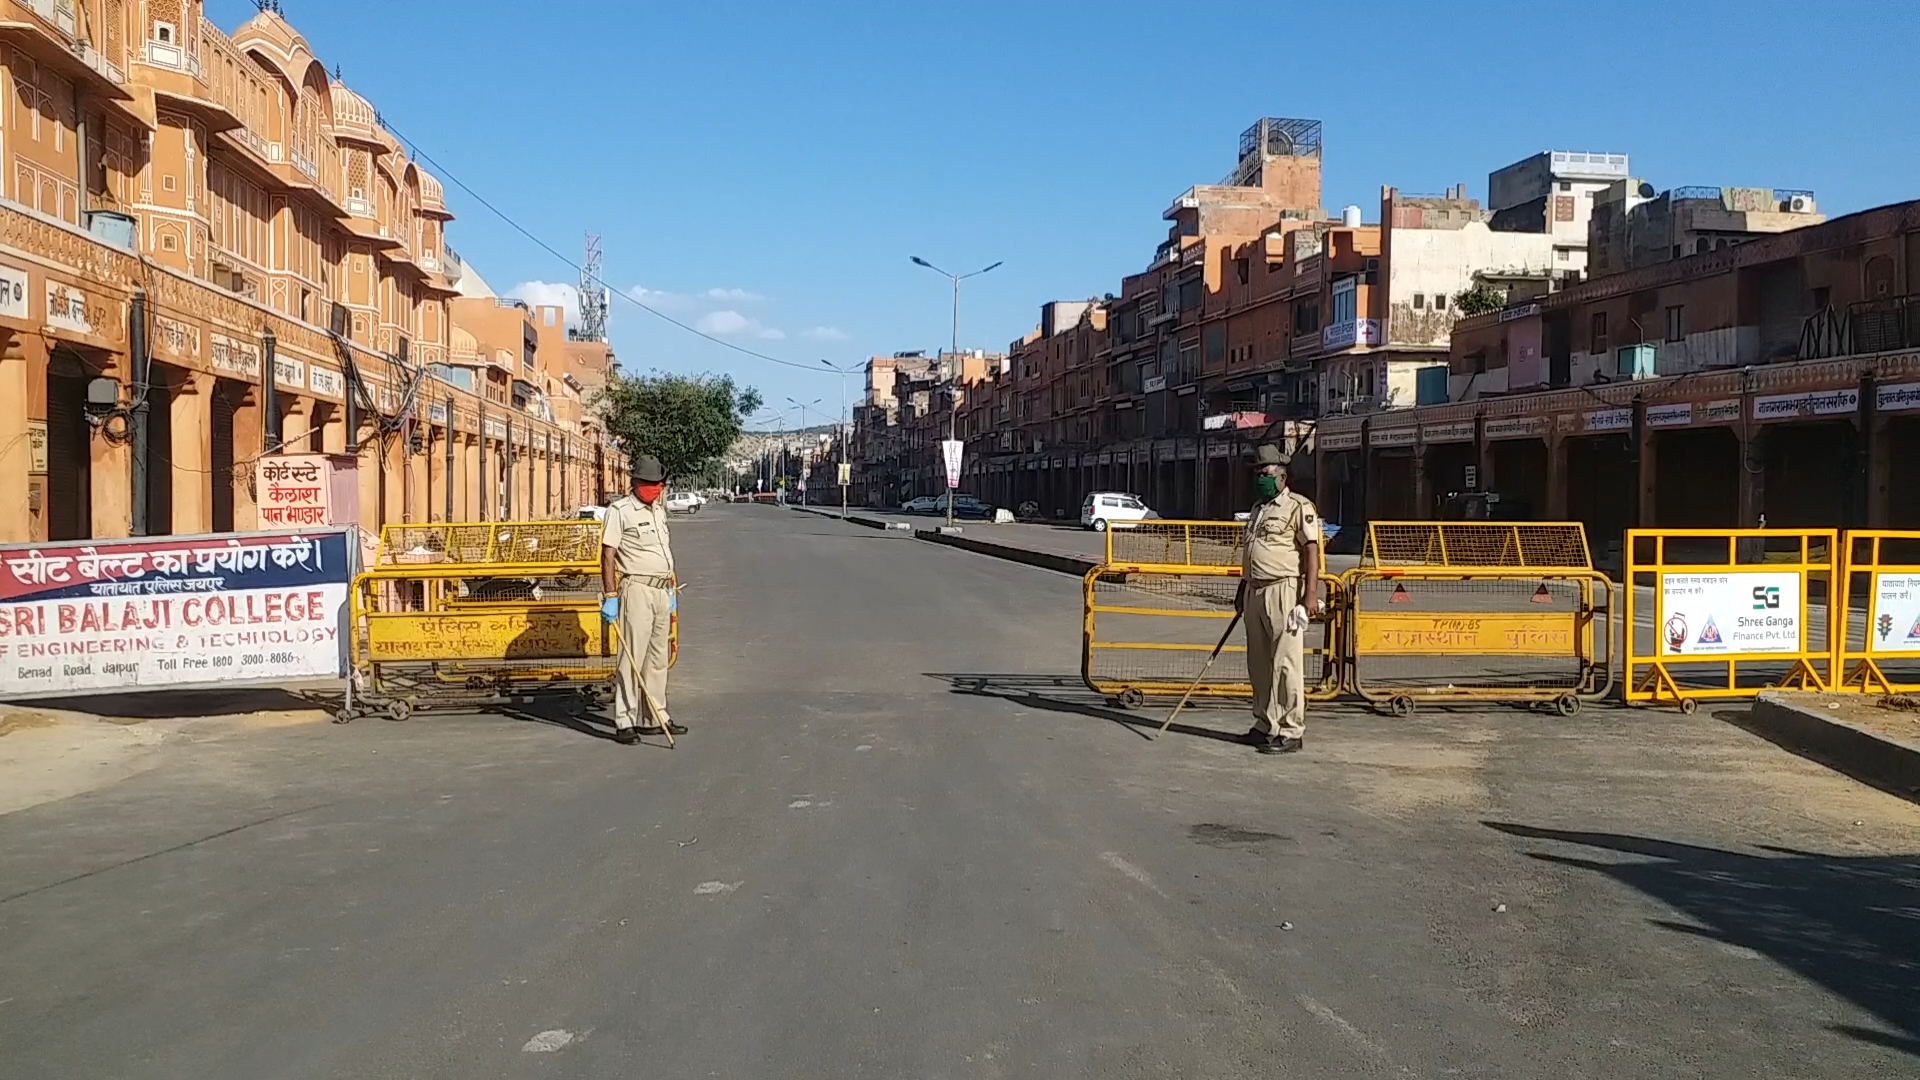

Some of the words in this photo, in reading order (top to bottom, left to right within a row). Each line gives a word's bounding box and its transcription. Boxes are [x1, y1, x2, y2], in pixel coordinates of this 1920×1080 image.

[268, 482, 321, 504] कैलाश
[261, 507, 286, 525] पान
[285, 505, 326, 525] भण्डार
[5, 549, 74, 585] सीट
[75, 546, 149, 582] बैल्ट
[148, 549, 191, 576] का
[191, 539, 269, 575] प्रयोग
[89, 580, 142, 596] यातायात
[143, 576, 183, 595] पुलिस
[183, 577, 228, 593] जयपुर
[1882, 580, 1905, 588] यातायात
[1881, 592, 1897, 600] पालन
[0, 605, 45, 637] SRI
[57, 600, 171, 634] BALAJI
[182, 591, 325, 627] COLLEGE
[1737, 616, 1764, 627] Shree
[1765, 615, 1794, 628] Ganga
[17, 636, 164, 658] ENGINEERING
[176, 635, 189, 649] &
[200, 627, 337, 648] TECHNOLOGY
[1733, 631, 1764, 641] Finance
[1765, 630, 1781, 640] Pvt.
[1782, 629, 1797, 639] Ltd.
[102, 662, 140, 677] Jaipur
[157, 658, 177, 670] Toll
[183, 657, 208, 669] Free
[212, 655, 233, 667] 1800
